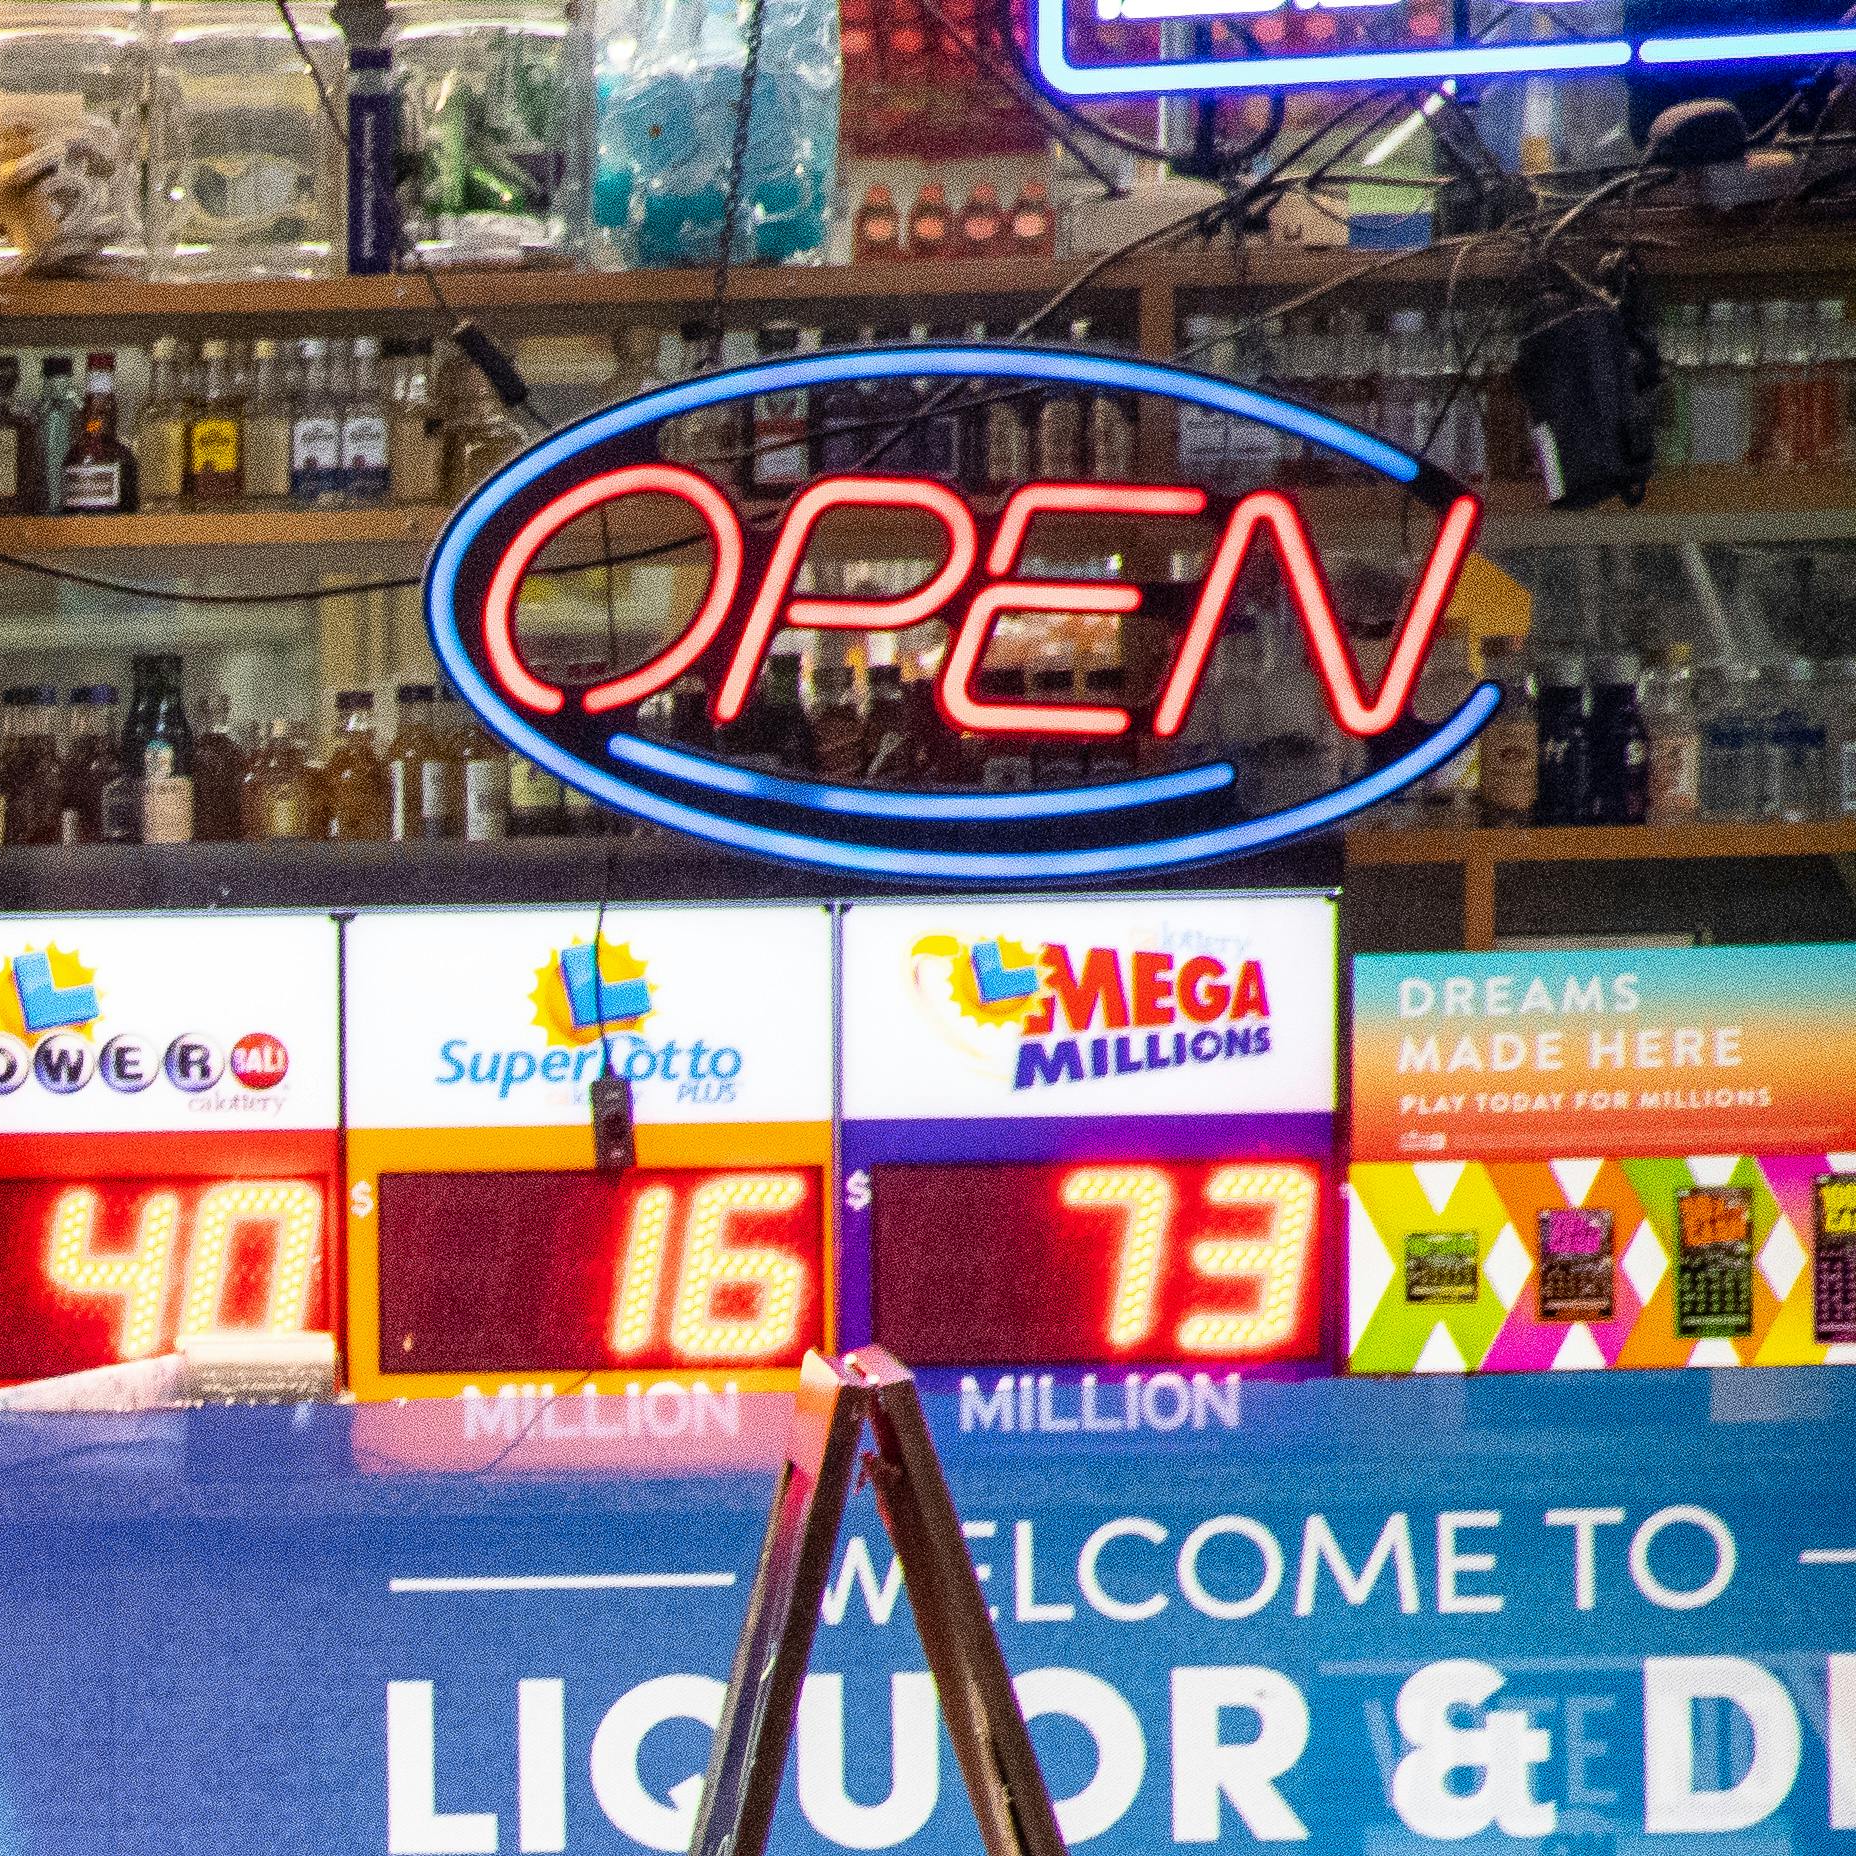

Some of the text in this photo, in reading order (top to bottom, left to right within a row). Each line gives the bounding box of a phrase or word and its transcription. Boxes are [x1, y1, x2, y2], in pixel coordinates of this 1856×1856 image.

[483, 462, 1480, 738] OPEN
[1021, 942, 1271, 1036] MEGA
[1398, 975, 1639, 1018] DREAMS
[1012, 1026, 1274, 1091] MILLIONS
[1398, 1028, 1739, 1072] MADE HERE
[1400, 1088, 1769, 1114] PLAY TODAY FOR MILLIONS
[46, 1182, 326, 1360] 40
[349, 1172, 806, 1358] $ 16
[846, 1172, 872, 1210] $
[1060, 1164, 1318, 1350] 73
[462, 1380, 740, 1440] MILLION
[958, 1372, 1242, 1434] MILLION
[1545, 1506, 1735, 1609] TO
[385, 1664, 1310, 1855] LIQUOR
[1390, 1659, 1557, 1841] &
[1644, 1654, 1856, 1834] D
